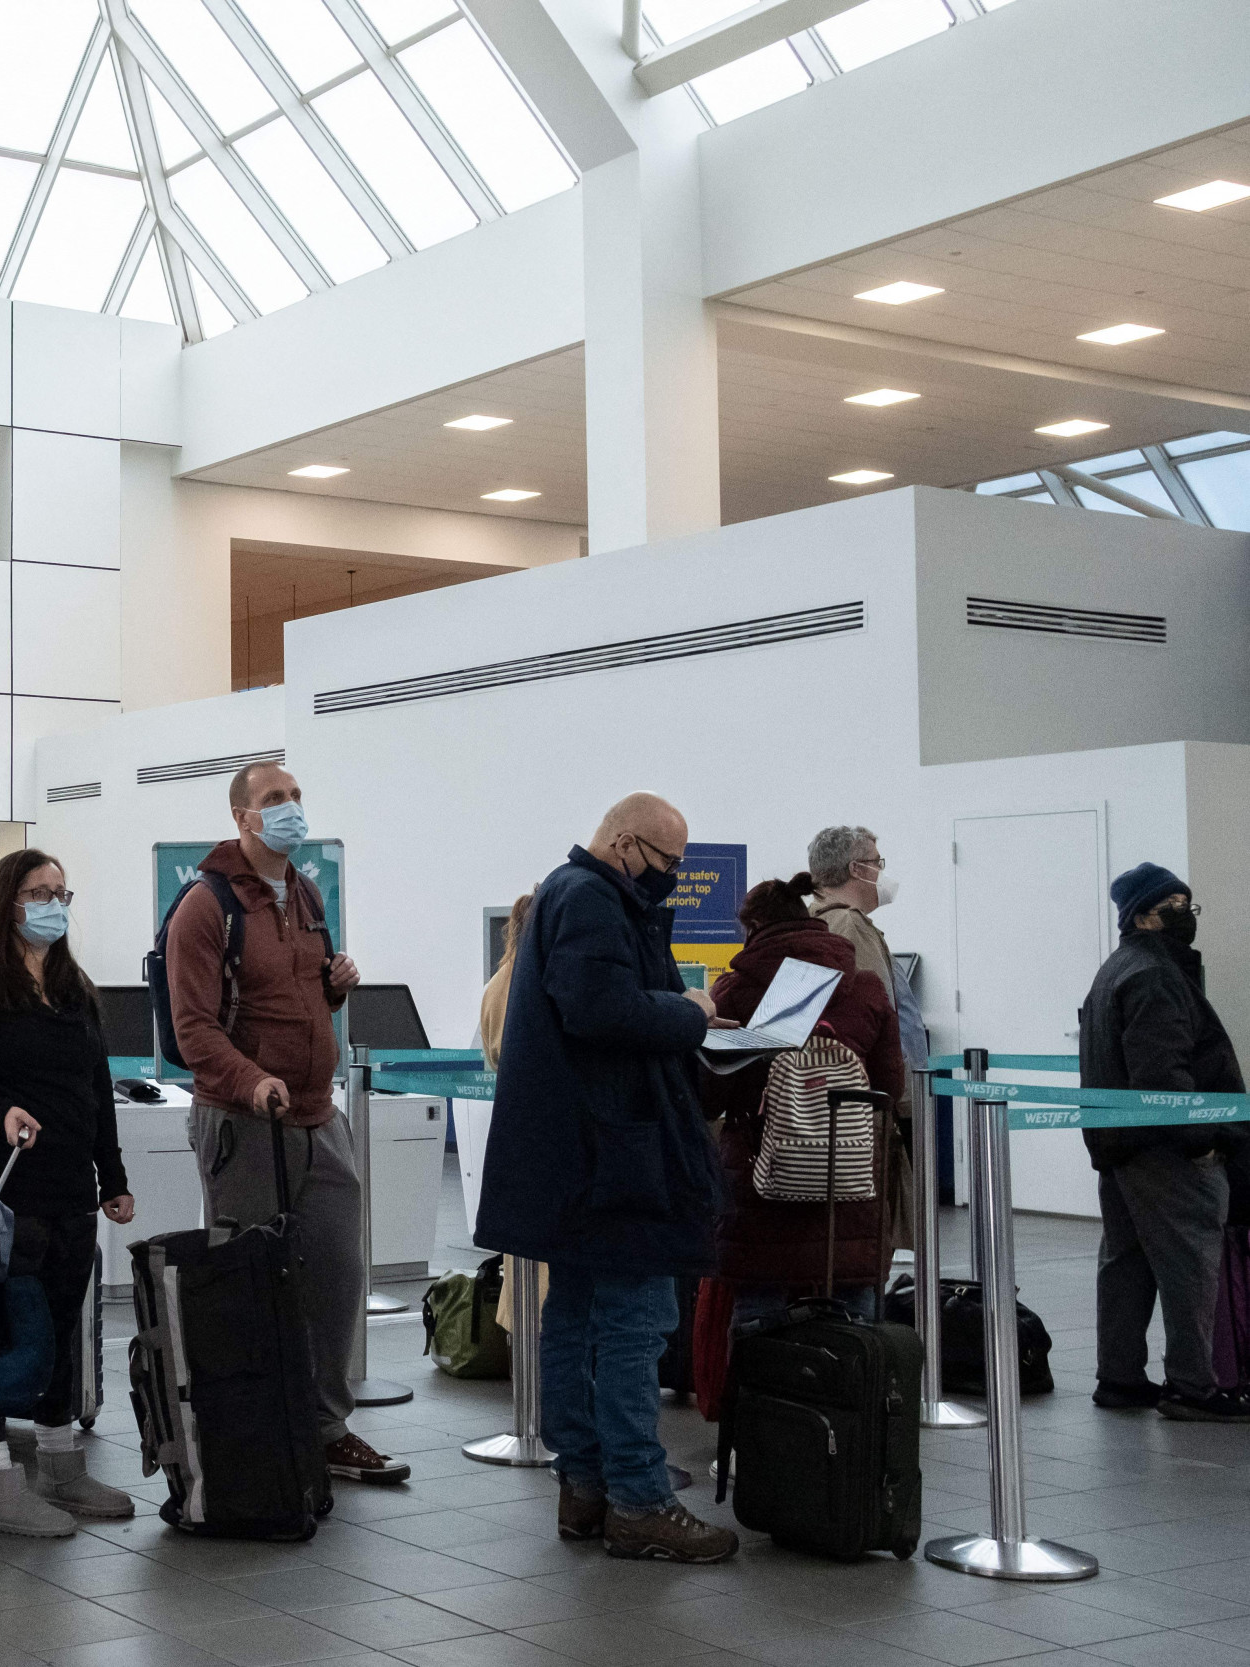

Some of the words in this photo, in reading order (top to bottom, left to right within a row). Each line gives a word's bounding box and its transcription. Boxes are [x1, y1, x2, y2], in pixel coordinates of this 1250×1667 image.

[690, 870, 720, 883] safety
[677, 885, 693, 893] our
[695, 884, 711, 895] top
[666, 896, 701, 908] priority
[456, 1085, 485, 1098] WESTJET
[963, 1083, 1008, 1097] WESTJET
[1140, 1094, 1191, 1107] WESTJET
[1025, 1111, 1070, 1127] WESTJET
[1188, 1107, 1229, 1120] WESTJET
